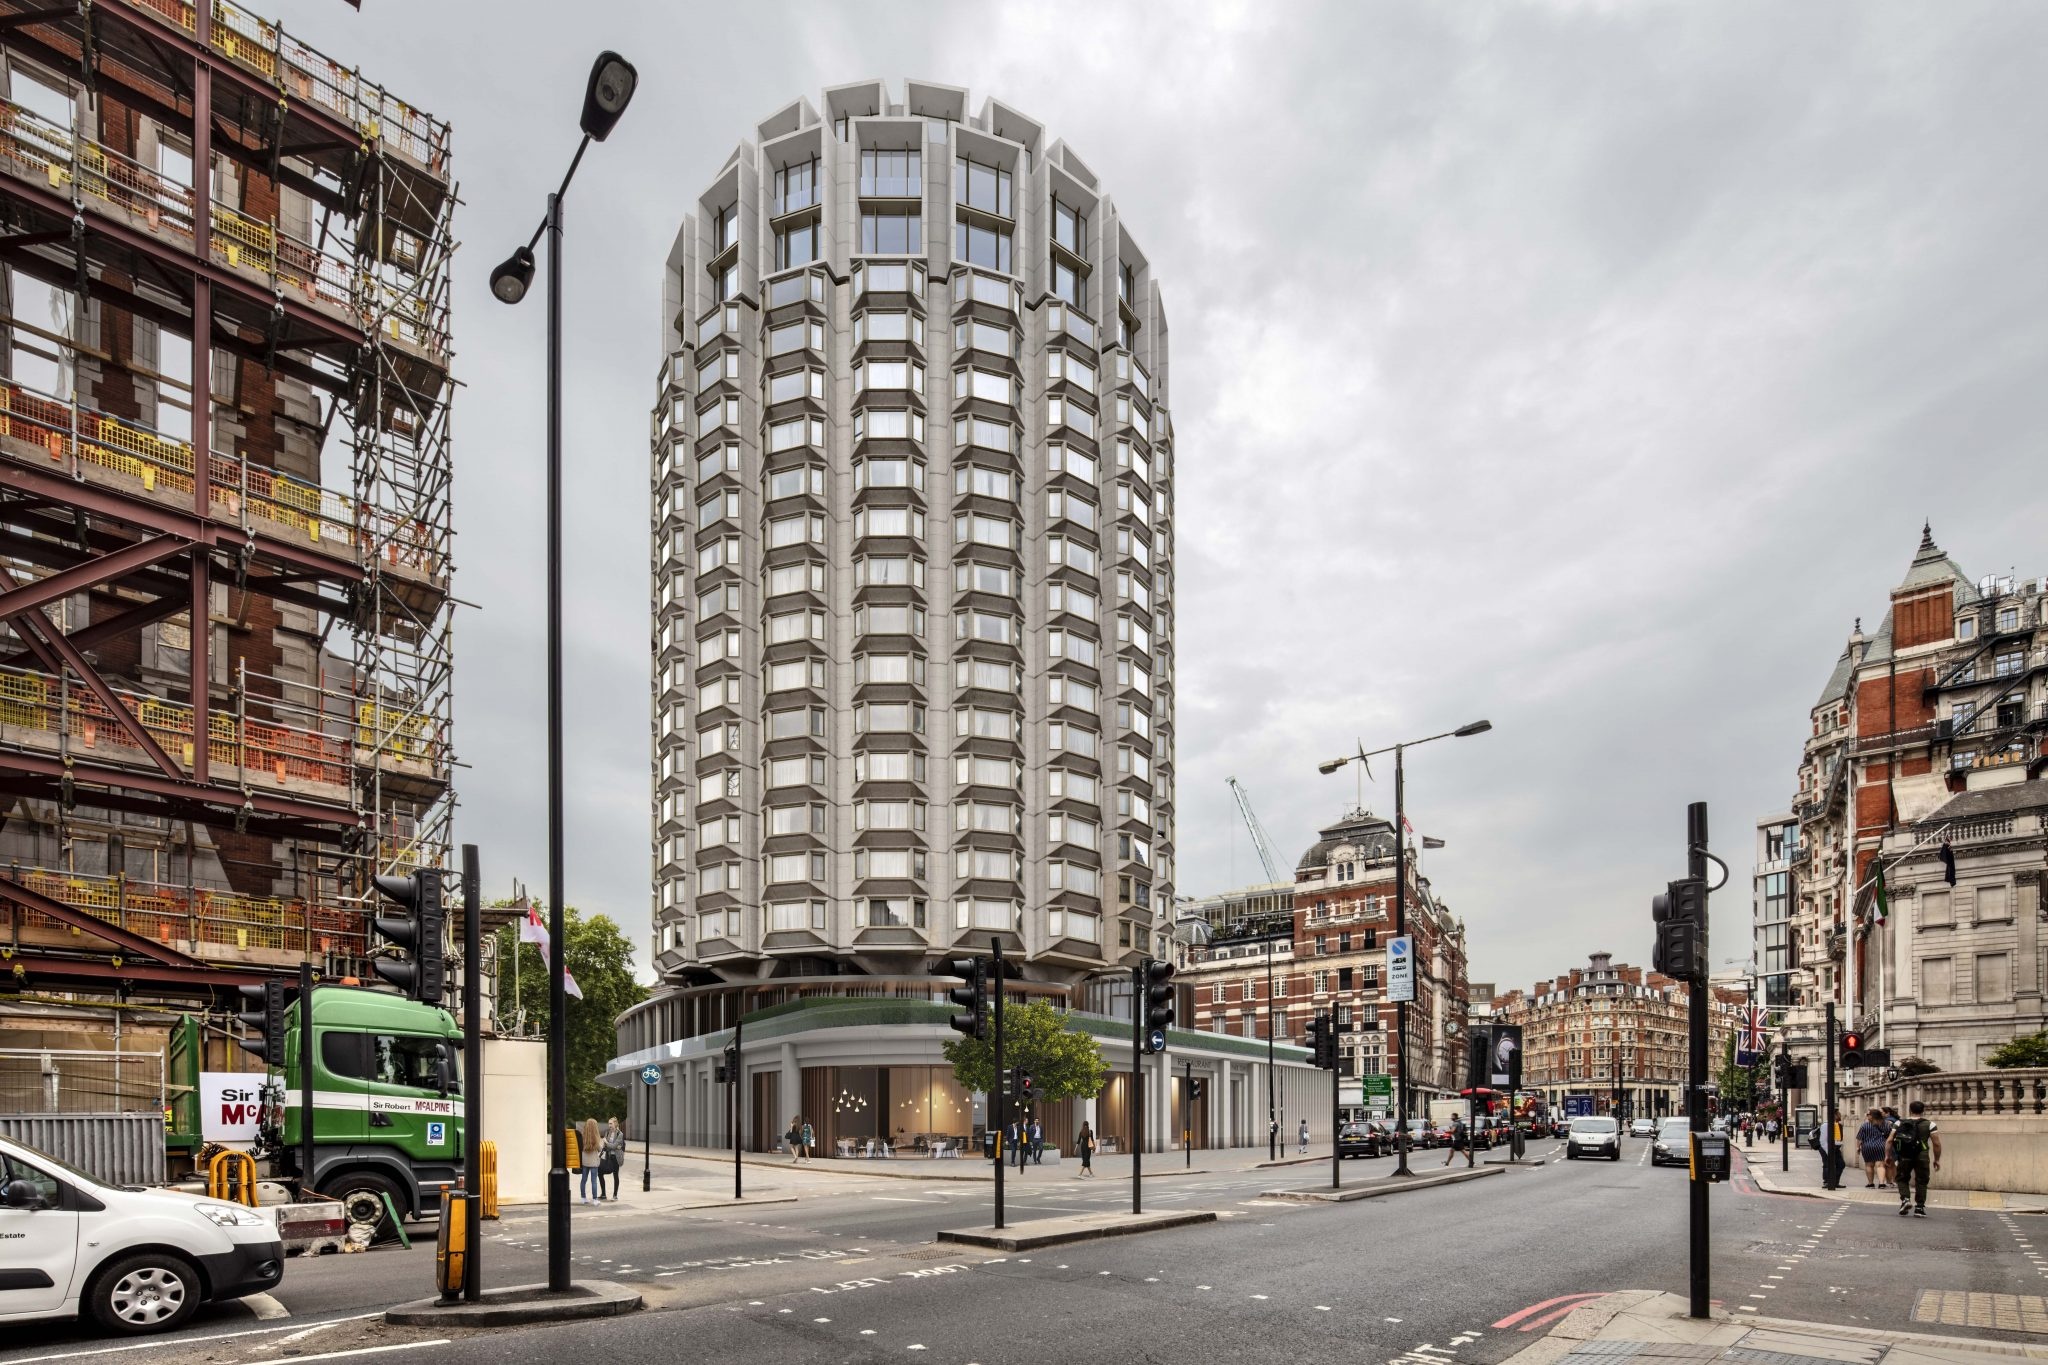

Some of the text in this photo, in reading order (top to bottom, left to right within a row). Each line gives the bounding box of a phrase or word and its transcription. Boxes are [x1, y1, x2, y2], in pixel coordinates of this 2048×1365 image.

[221, 1089, 254, 1102] Sir
[384, 1102, 411, 1110] Robert
[415, 1101, 450, 1112] McALPINE
[810, 1264, 970, 1294] LOOK LEFT
